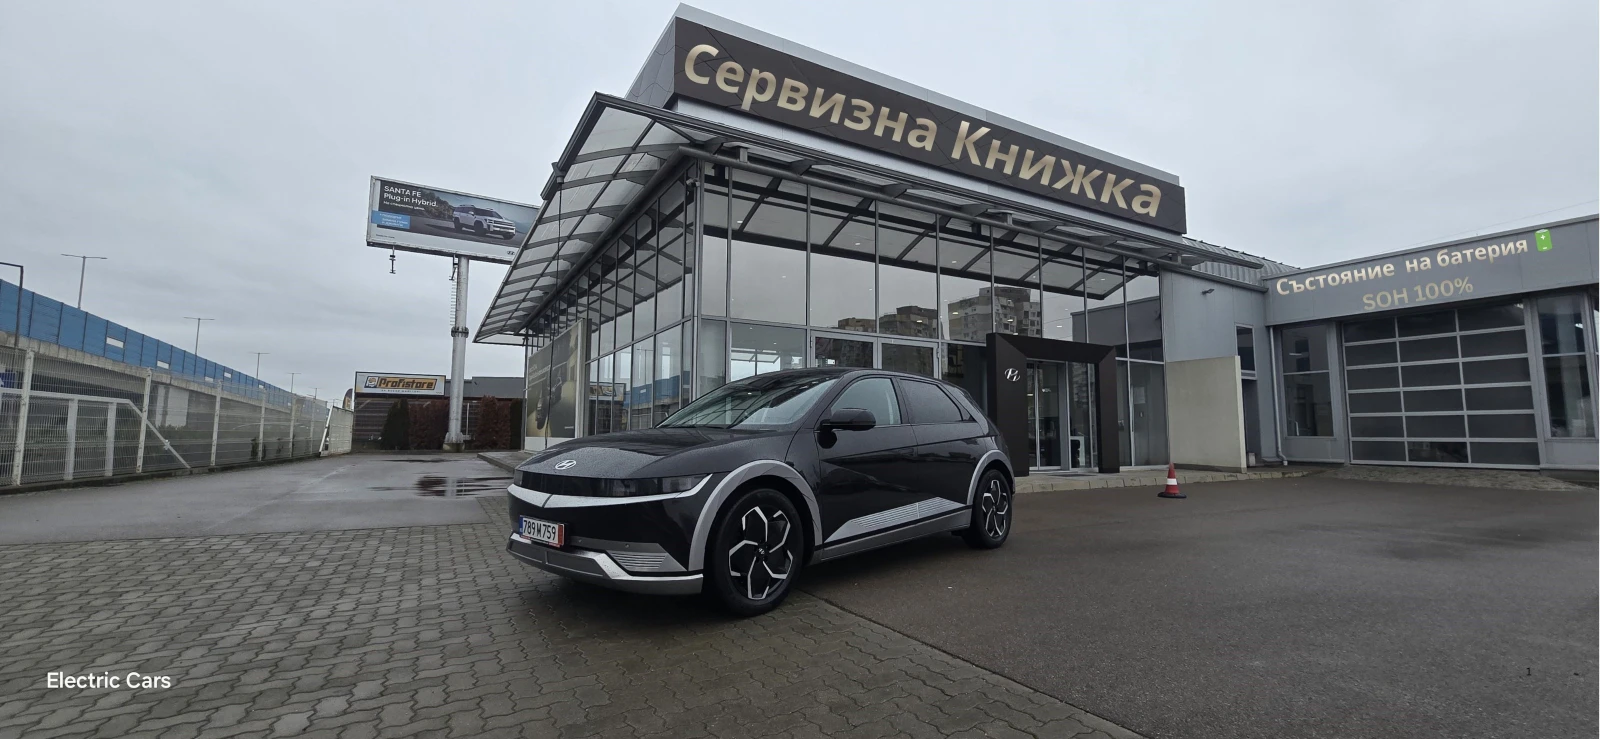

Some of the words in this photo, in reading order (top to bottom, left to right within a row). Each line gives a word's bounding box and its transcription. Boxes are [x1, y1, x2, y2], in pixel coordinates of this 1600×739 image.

[384, 185, 410, 195] SANTA
[383, 193, 410, 202] Plug-in
[379, 377, 434, 389] Profistore
